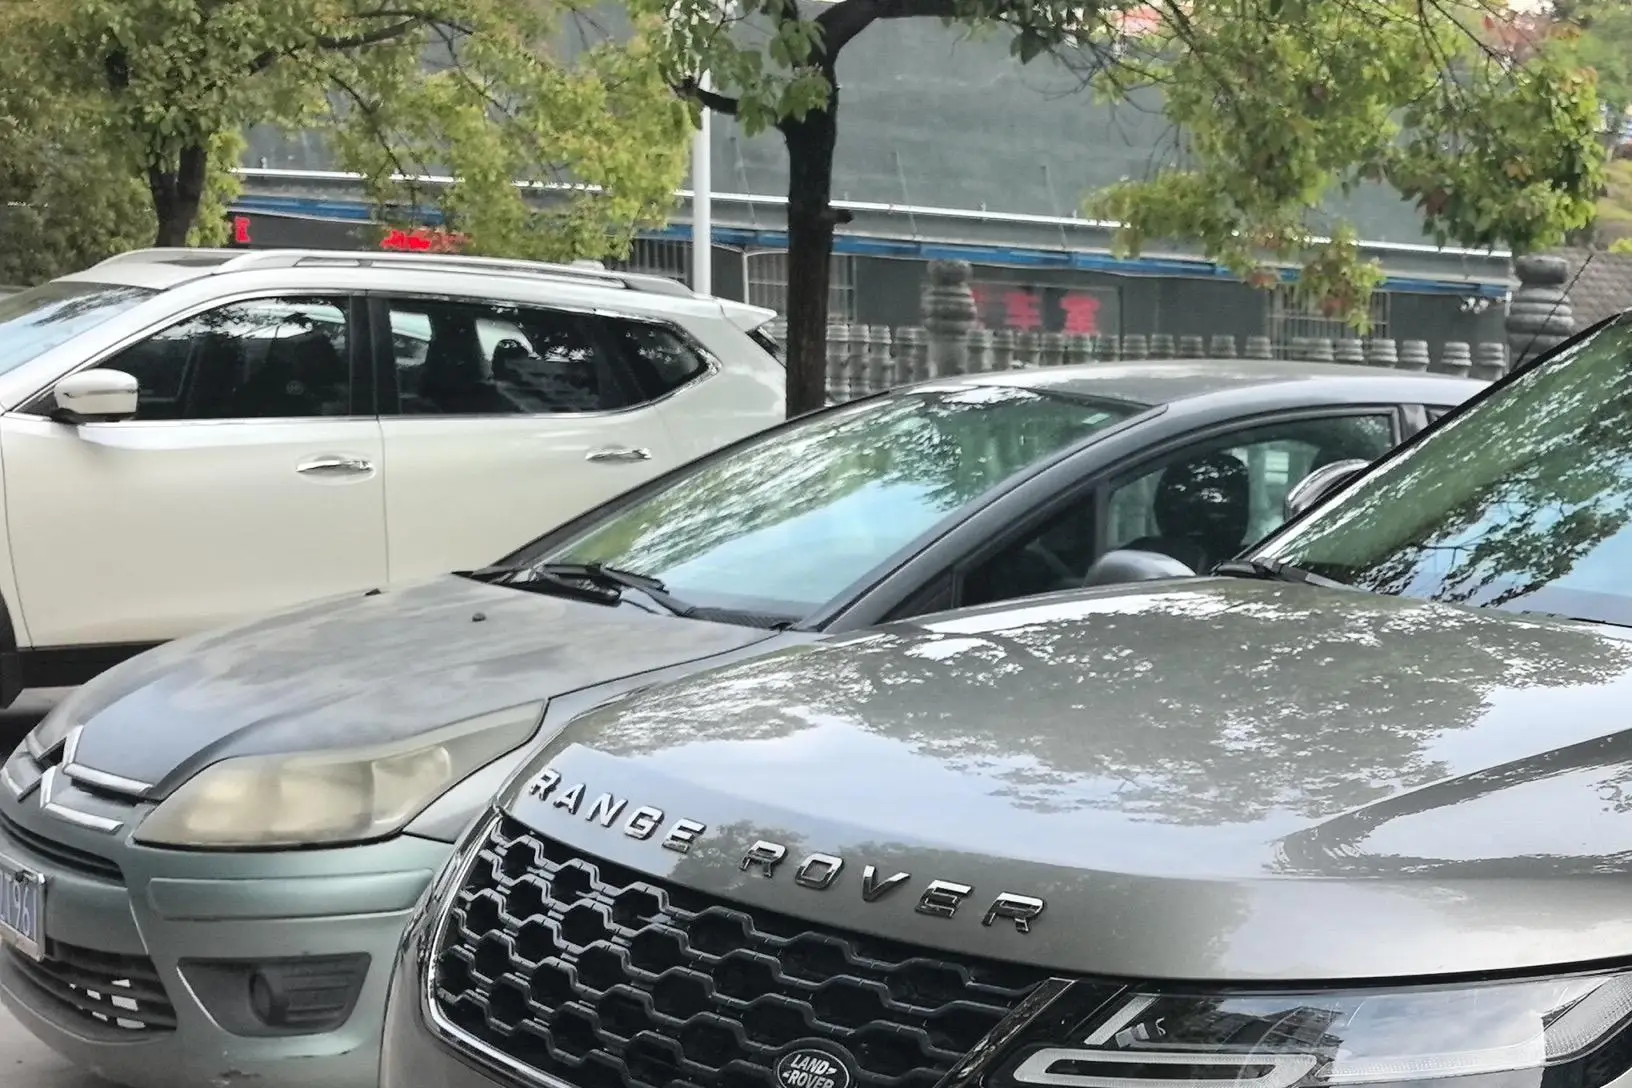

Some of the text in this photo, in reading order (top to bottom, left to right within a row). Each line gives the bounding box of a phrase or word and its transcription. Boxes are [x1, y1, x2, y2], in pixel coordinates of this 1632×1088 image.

[528, 767, 1046, 933] RANGE ROVER
[791, 1054, 830, 1075] LAND
